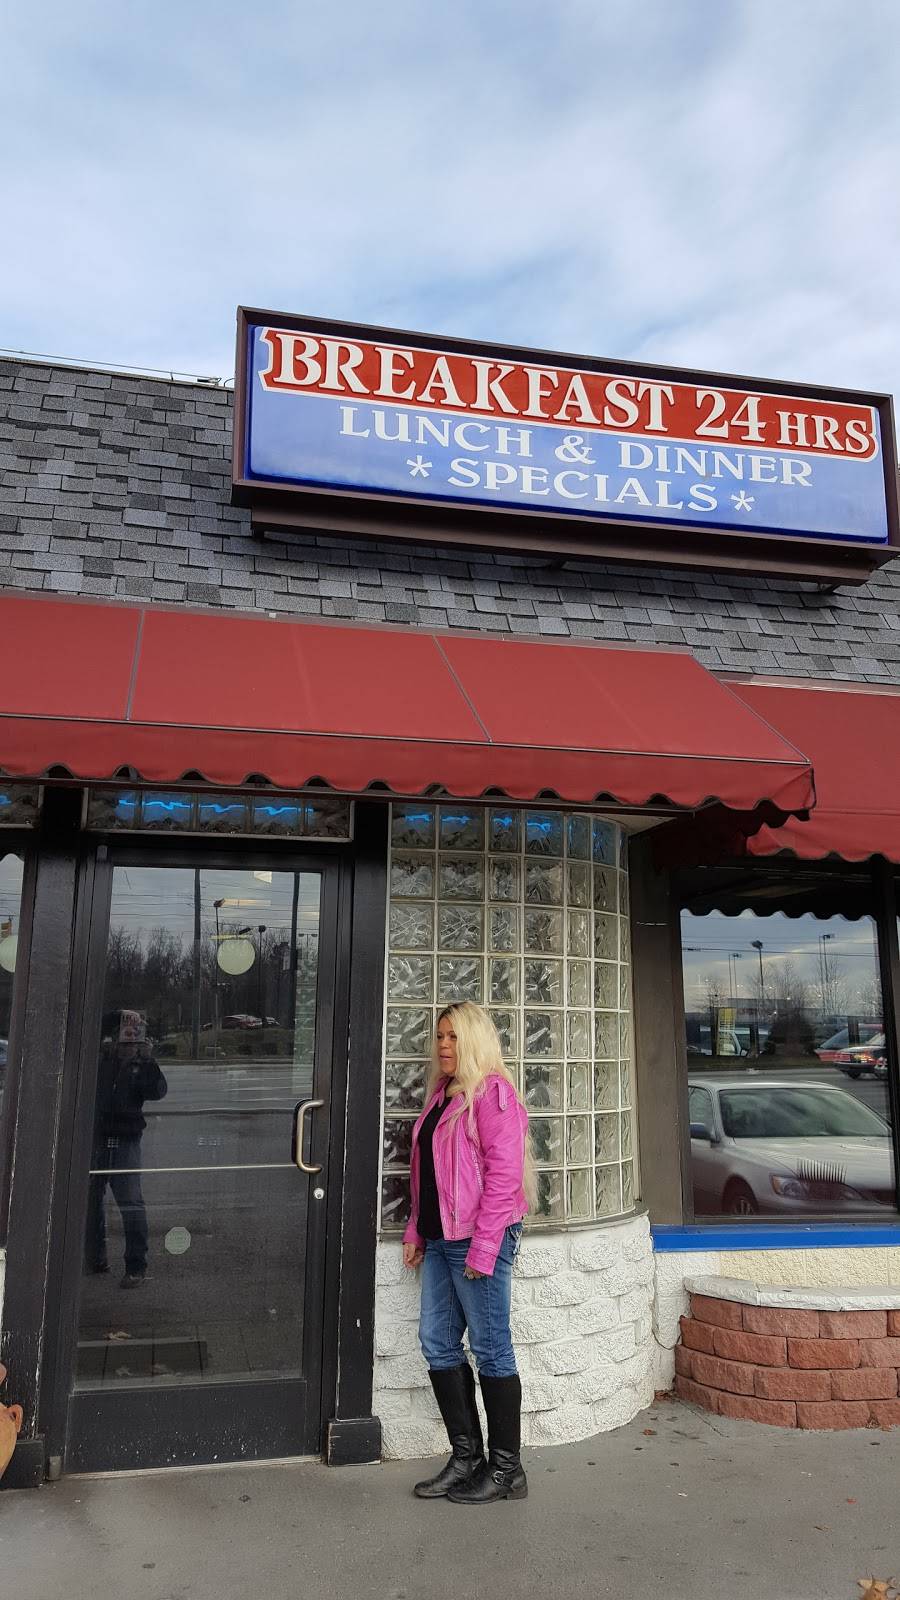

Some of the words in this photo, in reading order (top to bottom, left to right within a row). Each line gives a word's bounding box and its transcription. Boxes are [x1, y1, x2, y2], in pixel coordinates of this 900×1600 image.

[273, 333, 675, 432] BREAKFAST
[695, 390, 767, 442] 24
[776, 410, 870, 453] HRS
[339, 406, 533, 457] LUNCH
[554, 435, 596, 465] &
[618, 441, 812, 487] DINNER
[447, 458, 718, 512] SPECIALS
